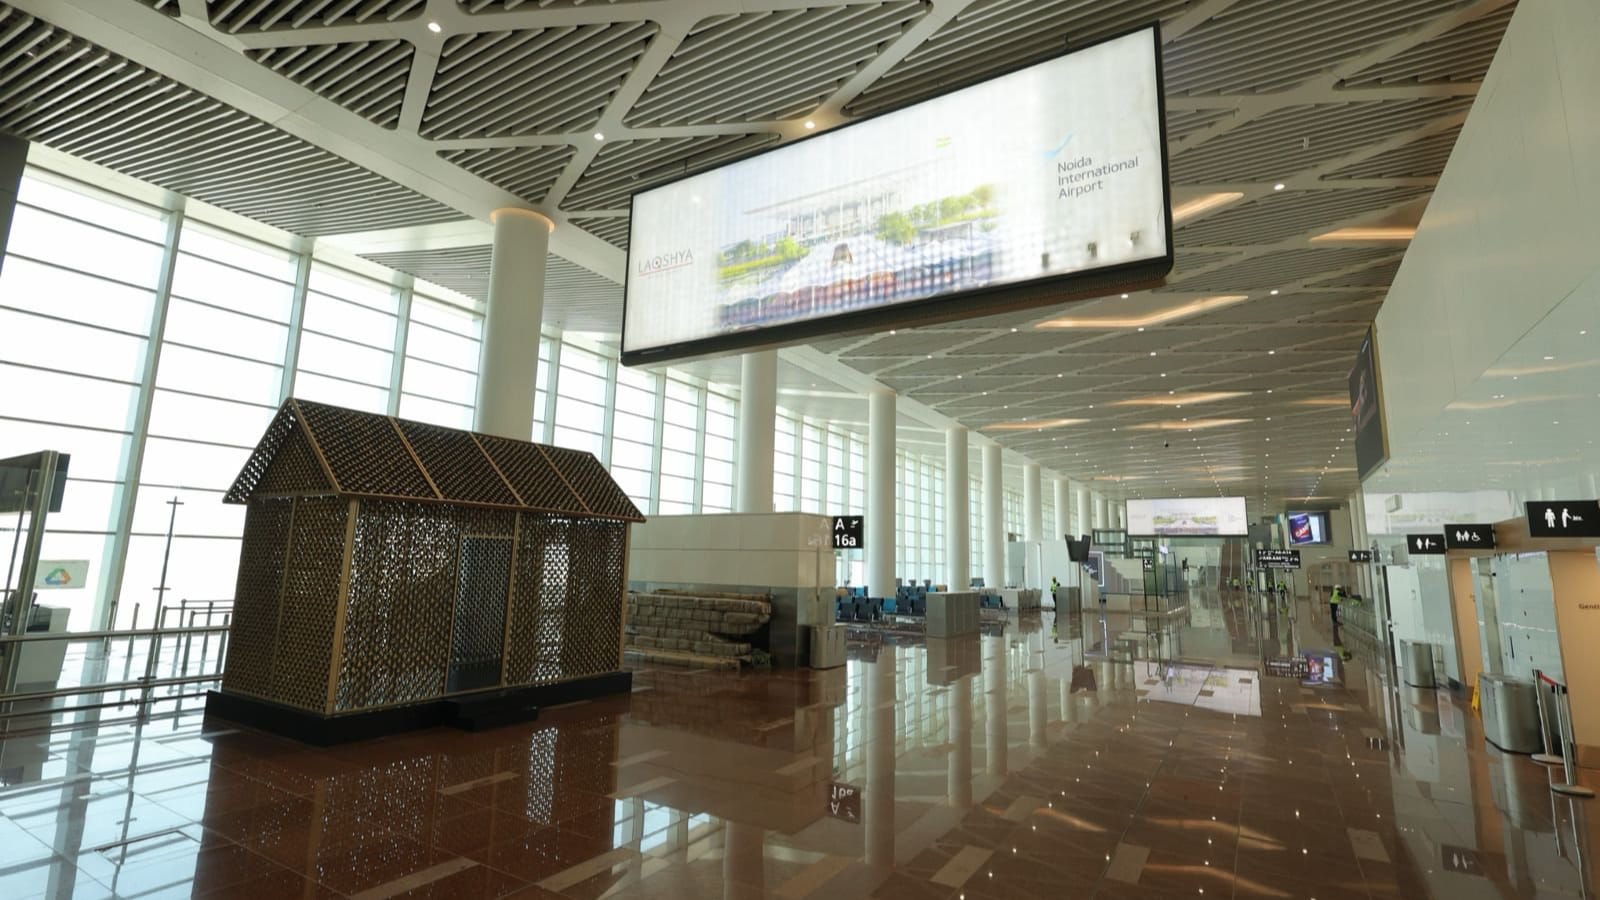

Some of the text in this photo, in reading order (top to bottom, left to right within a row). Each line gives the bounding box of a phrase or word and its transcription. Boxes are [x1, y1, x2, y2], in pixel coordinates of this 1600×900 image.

[1058, 156, 1092, 173] Noida
[1058, 155, 1139, 186] International
[1058, 180, 1103, 199] Airport
[639, 248, 693, 273] LAQSHYA
[835, 518, 845, 530] A
[835, 534, 857, 546] 16a
